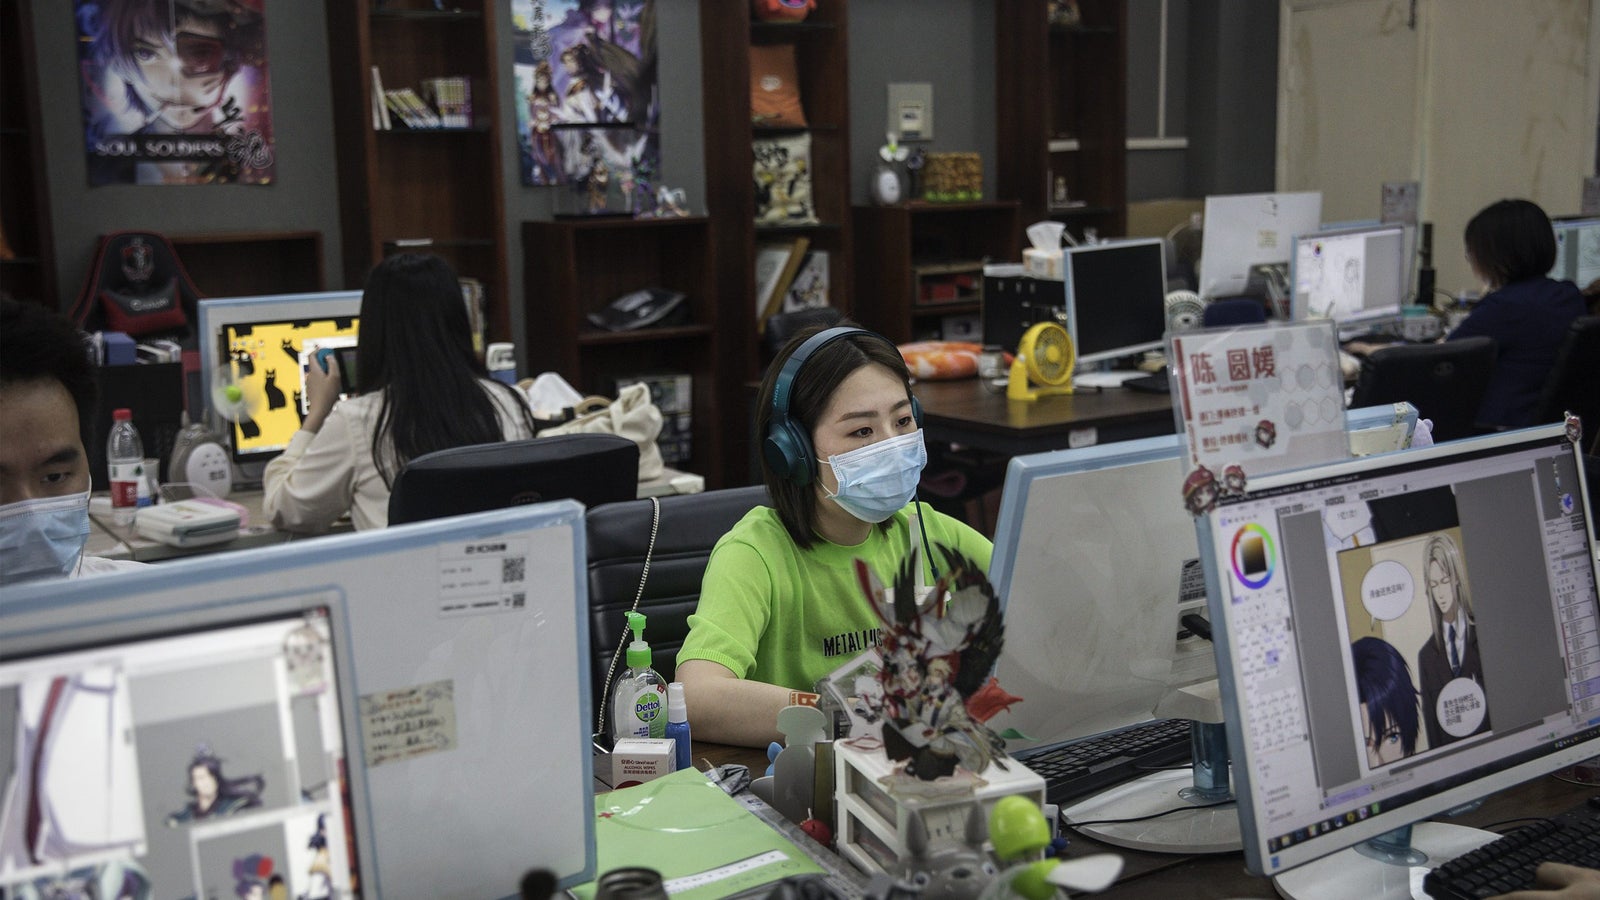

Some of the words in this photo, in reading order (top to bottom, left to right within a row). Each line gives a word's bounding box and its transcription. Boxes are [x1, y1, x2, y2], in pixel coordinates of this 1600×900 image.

[96, 139, 141, 157] SOUL
[145, 138, 225, 157] SOLDIERS
[1190, 352, 1217, 385] 陈
[1226, 345, 1277, 382] 圆媛
[636, 700, 660, 713] Dettol
